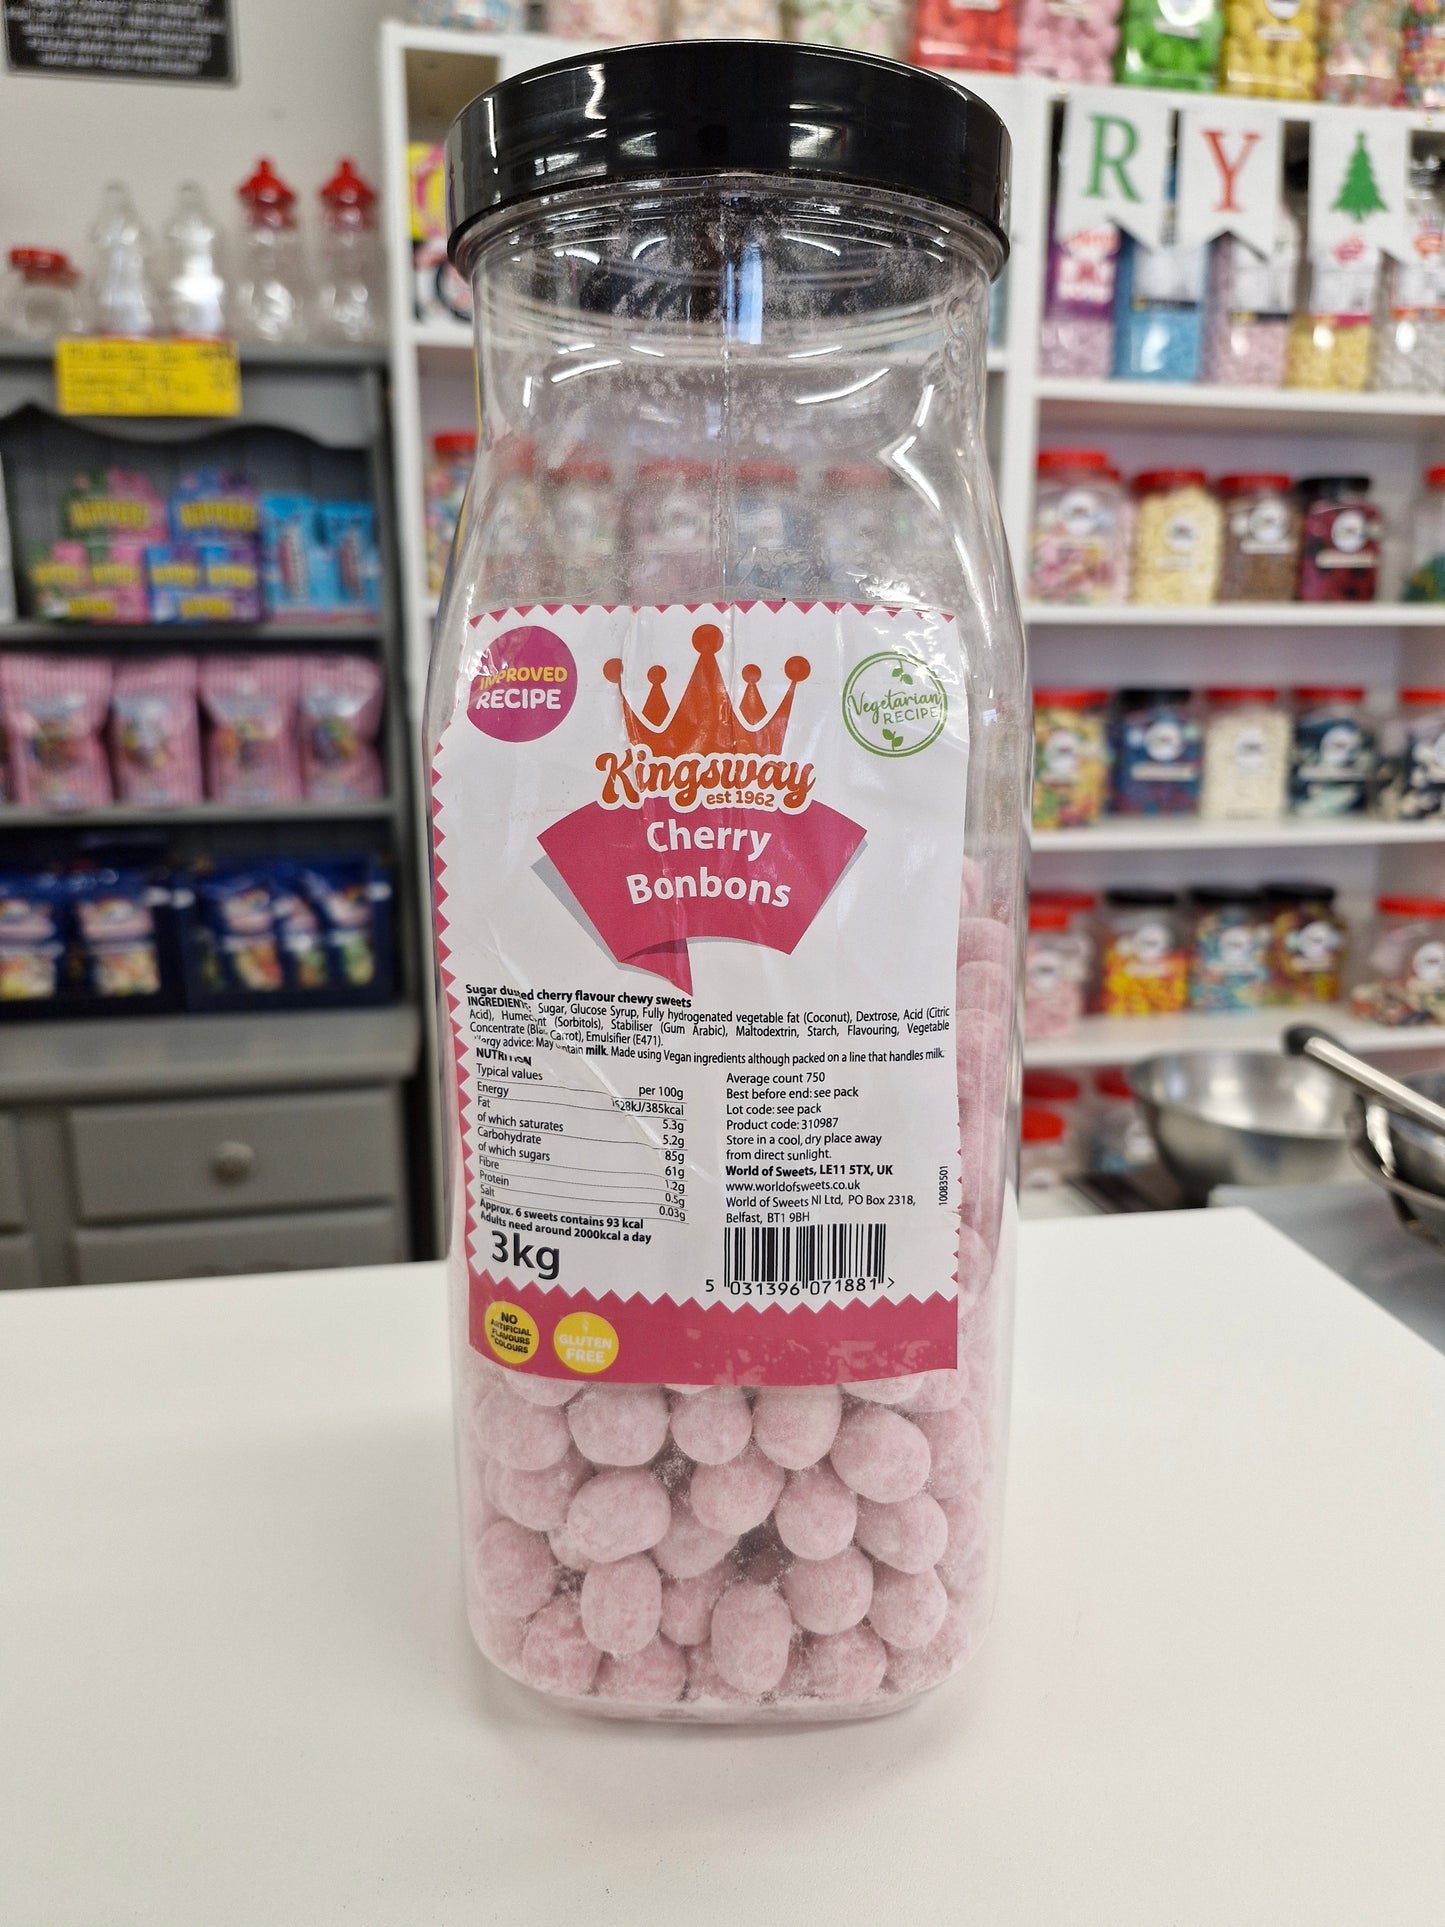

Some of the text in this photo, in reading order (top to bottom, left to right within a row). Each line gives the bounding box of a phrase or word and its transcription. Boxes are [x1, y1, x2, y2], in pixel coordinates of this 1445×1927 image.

[1083, 114, 1262, 213] R Y
[480, 666, 568, 690] IMPROVED
[476, 688, 561, 710] RECIPE
[847, 689, 942, 725] Vegetarian
[883, 706, 938, 725] RECIPE
[595, 748, 816, 808] Kingsway
[706, 791, 775, 807] est 1962
[646, 818, 772, 861] Cherry
[626, 866, 792, 908] Bonbons
[465, 984, 497, 996] Sugar
[537, 989, 572, 1003] cherry
[575, 990, 615, 1002] flavour
[618, 992, 653, 1006] chewy
[656, 996, 692, 1007] sweets
[538, 1003, 567, 1016] Sugar,
[570, 1003, 607, 1015] Glucose
[610, 1006, 639, 1019] Syrup,
[642, 1007, 664, 1021] Fully
[667, 1008, 733, 1024] hydrogenated
[736, 1012, 784, 1025] vegetable
[787, 1012, 800, 1023] fat
[803, 1011, 853, 1023] (Coconut),
[856, 1011, 900, 1022] Dextrose,
[903, 1008, 923, 1020] Acid
[926, 1006, 950, 1020] (Citric
[469, 1009, 950, 1038] Acid), Humecnt (Sorbitols), Stabiliser (Gum Arabic), Maltodextrin, Starch, Flavouring, Vegetable
[469, 1022, 524, 1034] Concentrate
[586, 1031, 631, 1043] Emulsifier
[633, 1034, 663, 1047] (E471).
[502, 1037, 534, 1047] advice:
[536, 1037, 553, 1050] May
[585, 1045, 609, 1056] milk.
[611, 1046, 635, 1058] Made
[637, 1049, 662, 1062] using
[663, 1050, 692, 1064] Vegan
[693, 1052, 746, 1066] ingredients
[748, 1053, 790, 1067] although
[792, 1052, 825, 1066] packed
[827, 1053, 839, 1062] on
[841, 1053, 847, 1062] a
[849, 1051, 866, 1062] line
[868, 1051, 887, 1062] that
[889, 1050, 924, 1062] handles
[925, 1047, 944, 1060] milk.
[476, 1063, 543, 1081] Typical values
[726, 1072, 826, 1086] Average count 750
[477, 1081, 509, 1098] Energy
[639, 1086, 684, 1100] per 100g
[726, 1086, 859, 1099] Best before end: see pack
[478, 1096, 491, 1108] Fat
[726, 1103, 822, 1116] Lot code: see pack
[477, 1112, 564, 1132] of which saturates
[662, 1119, 684, 1133] 5.3g
[726, 1117, 839, 1130] Product code: 310987
[477, 1126, 542, 1144] Carbohydrate
[662, 1135, 685, 1148] 5.2g
[726, 1133, 882, 1146] Store in a cool, dry place away
[478, 1142, 551, 1161] of which sugars
[664, 1150, 685, 1164] 85g
[726, 1148, 832, 1161] from direct sunlight.
[479, 1155, 500, 1170] Fibre
[725, 1164, 893, 1177] World of Sweets, LE11 5TX, UK
[479, 1170, 510, 1187] Protein
[664, 1166, 685, 1179] 61g
[480, 1184, 495, 1197] Salt
[665, 1179, 685, 1194] 1.2g
[726, 1179, 860, 1192] www.worldofsweets.co.uk
[938, 1165, 949, 1206] 10083501
[665, 1193, 685, 1208] 0.5g
[726, 1196, 757, 1207] World
[759, 1196, 771, 1207] of
[772, 1196, 809, 1207] Sweets
[824, 1194, 844, 1206] Ltd,
[848, 1195, 863, 1205] PO
[866, 1195, 885, 1205] Box
[888, 1195, 916, 1206] 2318,
[480, 1198, 644, 1229] Approx. 6 sweets contains 93 kcal
[659, 1206, 686, 1221] 0.03g
[726, 1211, 810, 1224] Belfast, BT1 9BH
[480, 1211, 652, 1244] Adults need around 2000kcal a day
[491, 1229, 560, 1280] 3kg
[705, 1279, 715, 1292] 5
[730, 1281, 800, 1296] 031396
[501, 1311, 518, 1324] NO
[491, 1328, 531, 1345] FLAVOURS
[559, 1334, 612, 1349] GLUTEN
[494, 1338, 529, 1354] COLOURS
[565, 1350, 606, 1364] FREE
